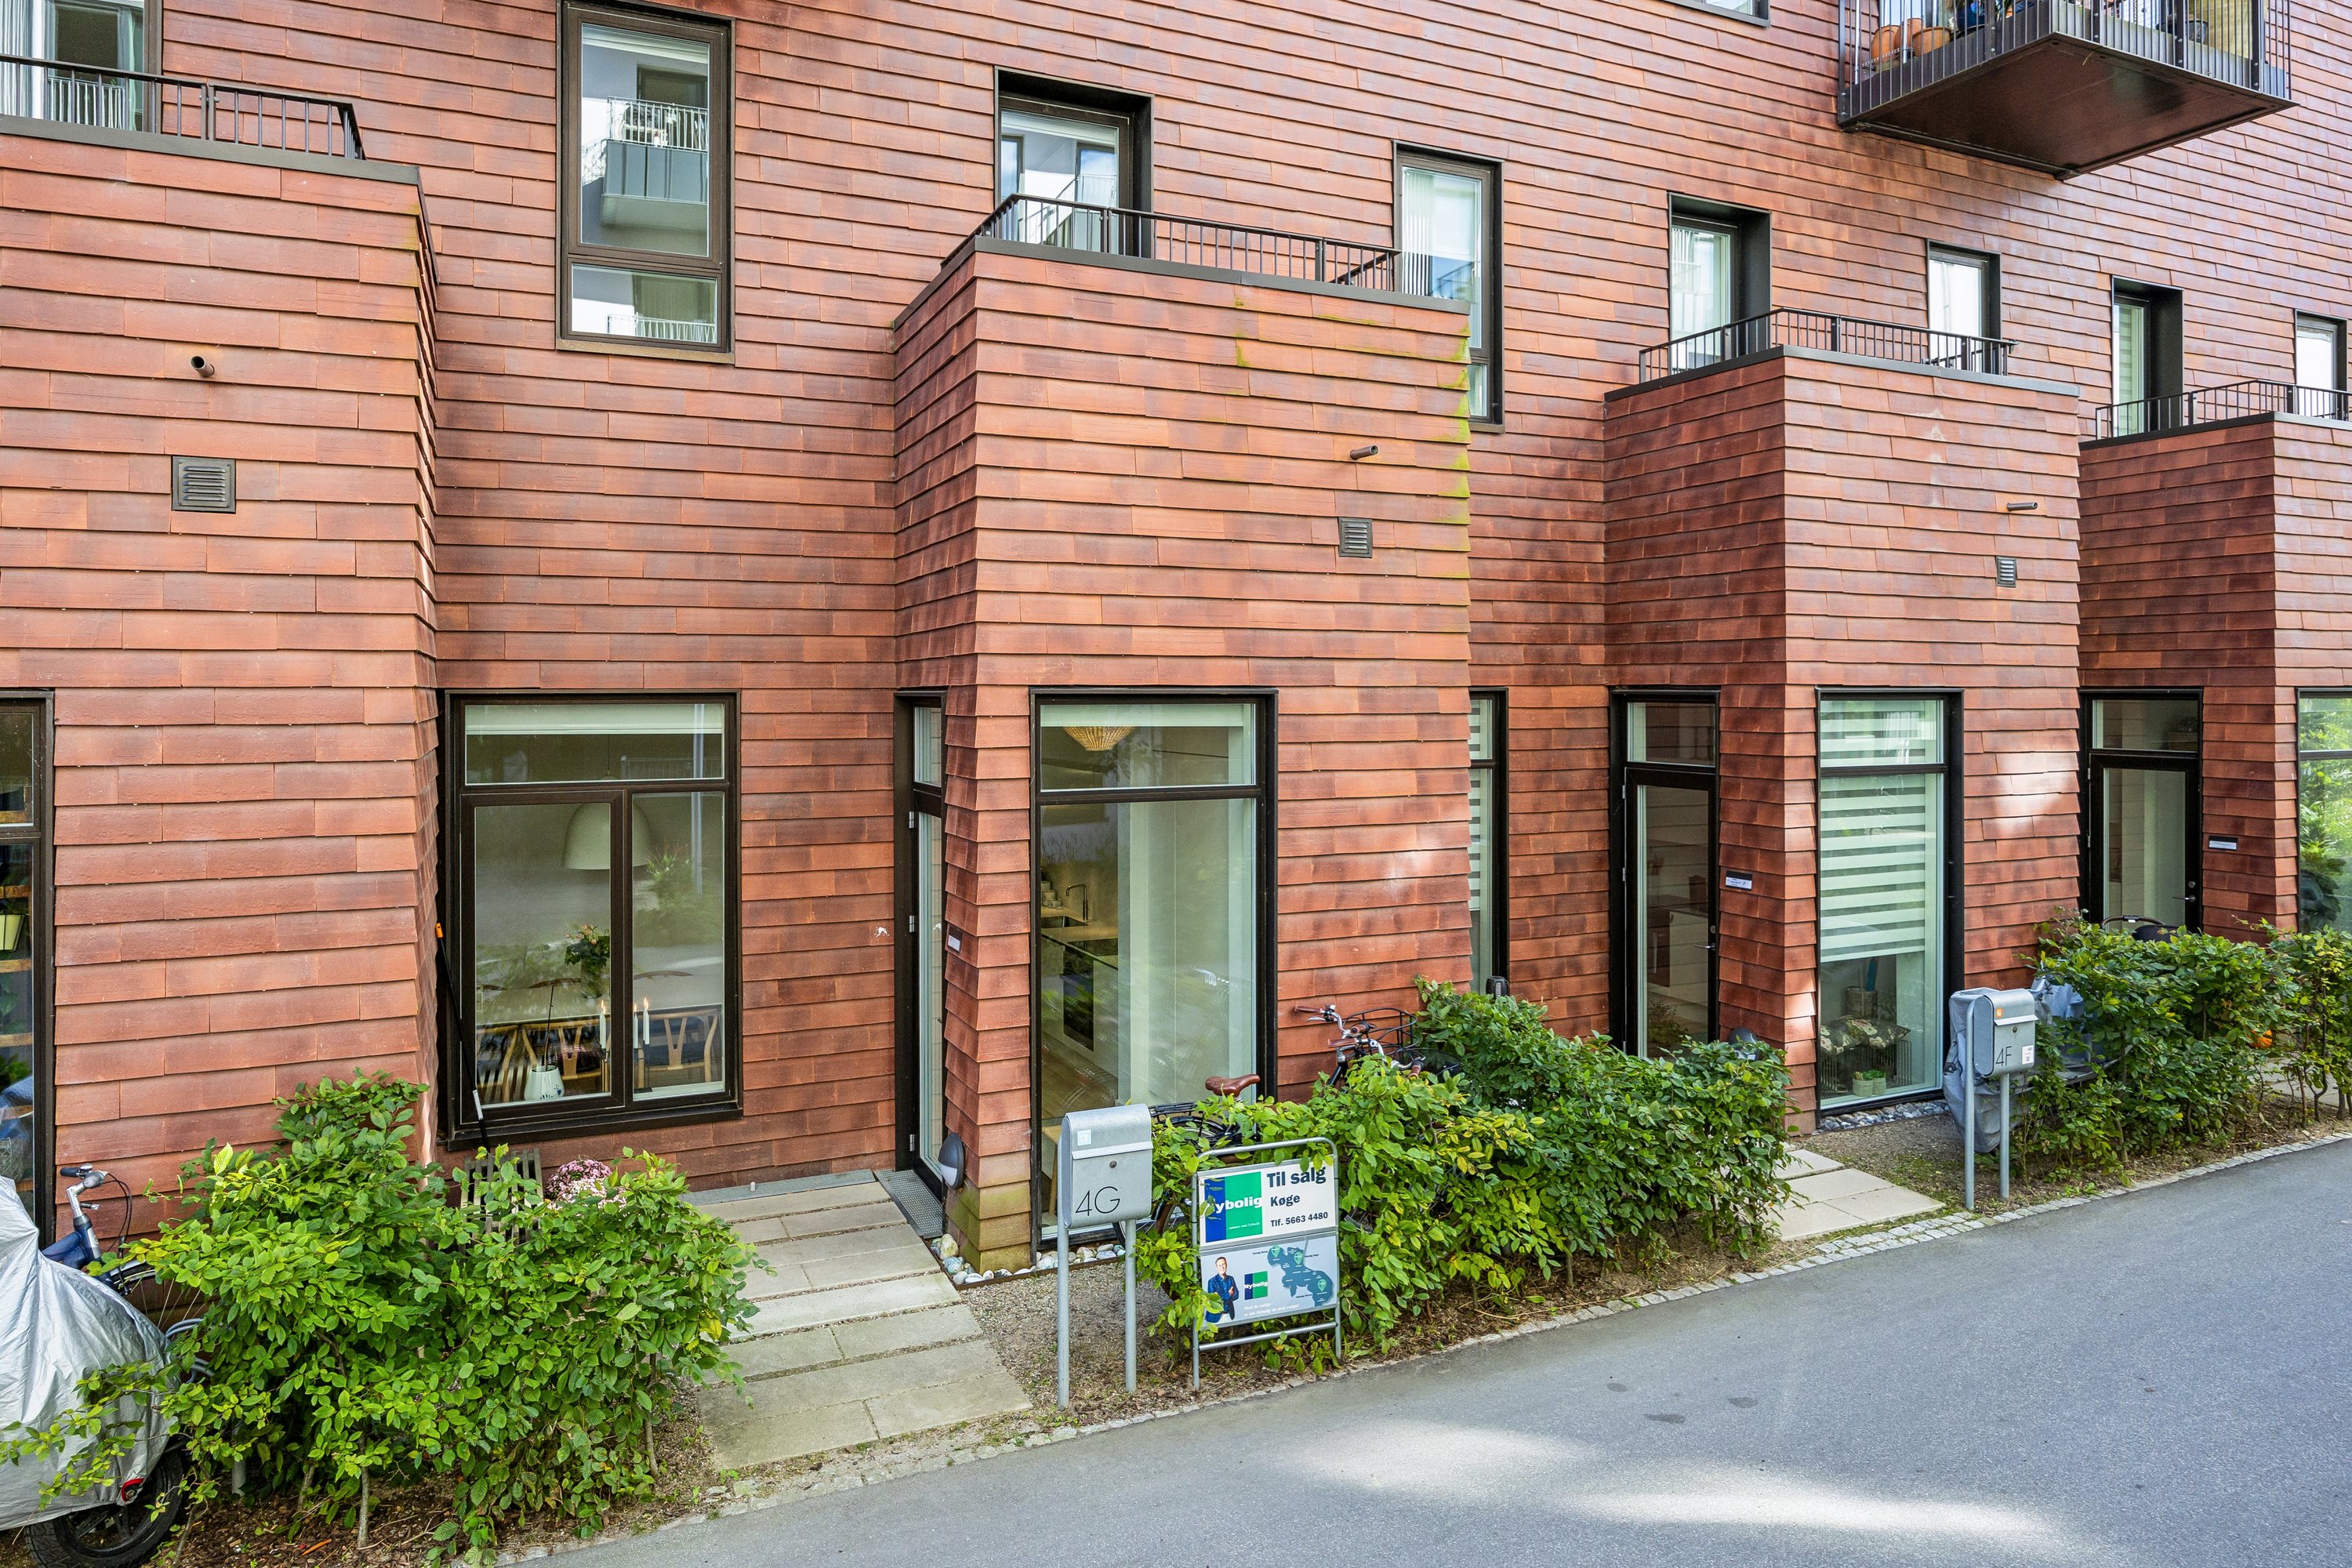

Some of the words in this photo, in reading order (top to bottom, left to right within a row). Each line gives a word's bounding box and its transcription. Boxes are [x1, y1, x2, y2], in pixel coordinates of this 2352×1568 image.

[1995, 1045, 2013, 1067] 4F
[1266, 1171, 1286, 1188] Til
[1290, 1167, 1327, 1185] salg
[1075, 1185, 1120, 1217] 4G
[1208, 1196, 1262, 1214] ybolig
[1270, 1194, 1301, 1207] Køge
[1270, 1219, 1283, 1228] Tlf.
[1285, 1216, 1306, 1225] 5663
[1308, 1211, 1329, 1221] 4480
[1244, 1280, 1268, 1290] Nybolig
